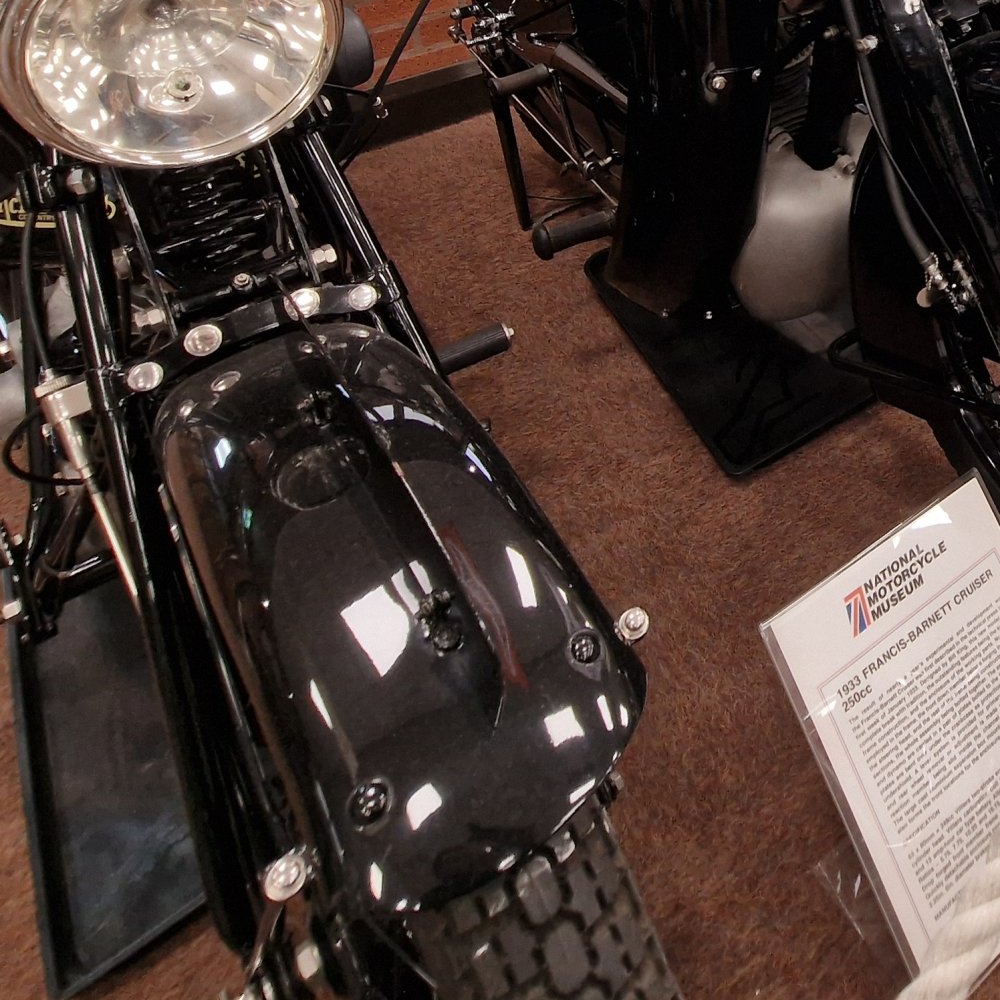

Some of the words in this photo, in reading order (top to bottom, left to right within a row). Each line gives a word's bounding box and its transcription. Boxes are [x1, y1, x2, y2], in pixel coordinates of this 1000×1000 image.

[863, 543, 925, 593] NATIONAL
[867, 540, 948, 607] MOTORCYCLE
[870, 574, 925, 623] MUSEUM
[836, 675, 862, 699] 1933
[862, 603, 953, 680] FRANCIS-BARNETT
[953, 568, 994, 607] CRUISER
[842, 684, 873, 713] 250cc
